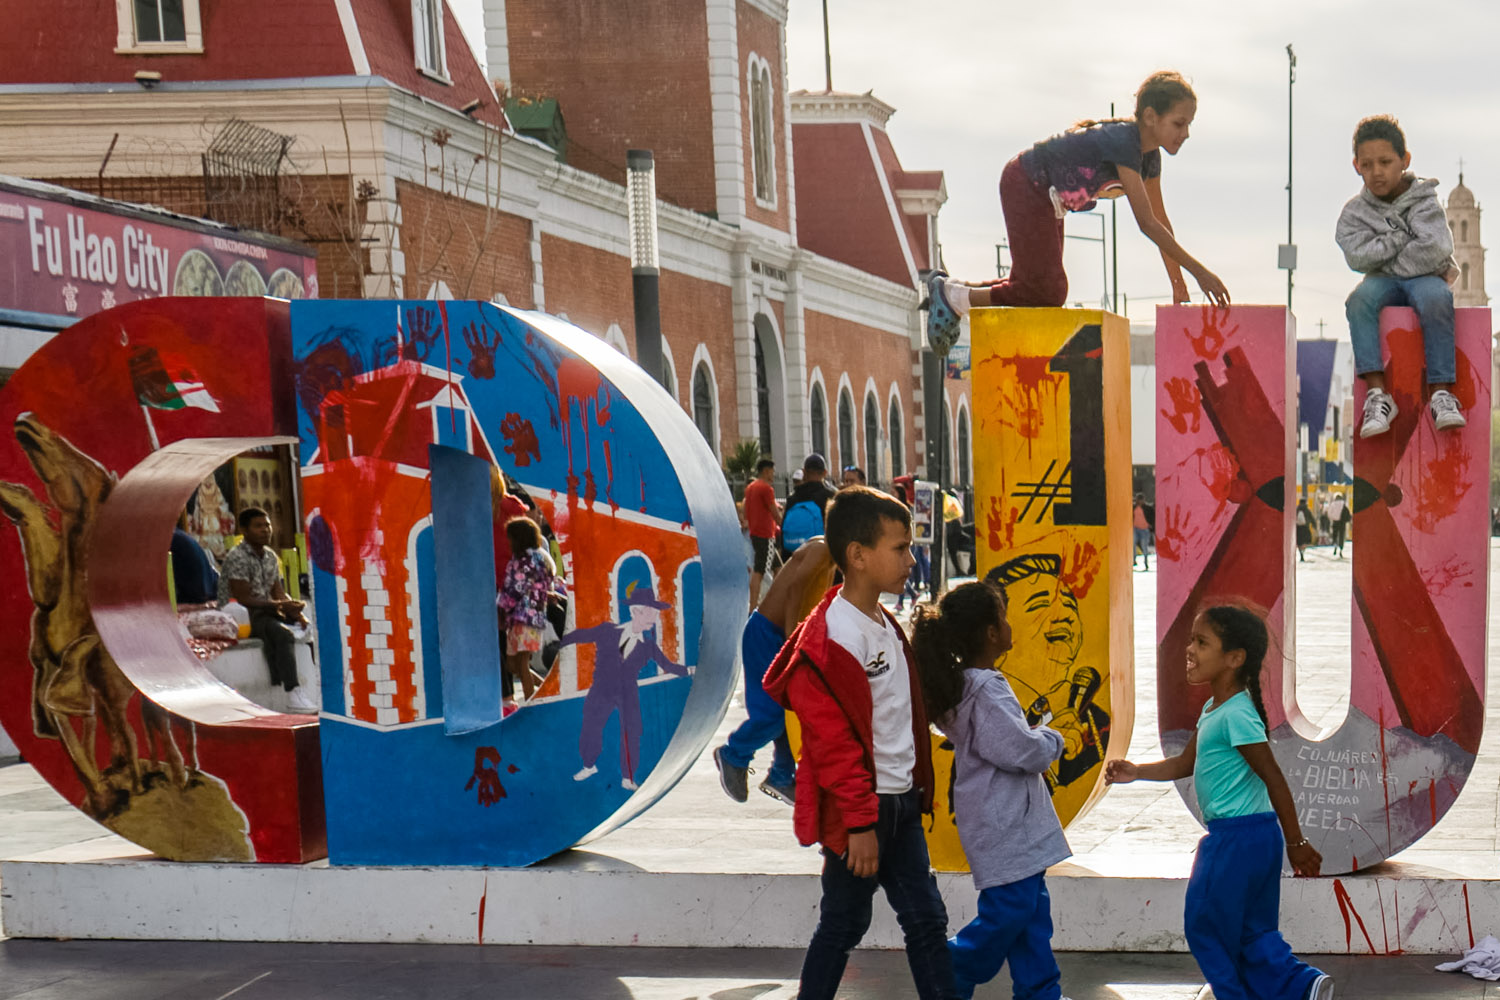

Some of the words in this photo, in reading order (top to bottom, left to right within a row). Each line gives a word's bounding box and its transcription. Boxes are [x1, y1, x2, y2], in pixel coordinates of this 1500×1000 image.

[28, 205, 64, 276] Fu
[67, 213, 118, 285] Hao
[122, 223, 169, 297] City
[1302, 764, 1373, 792] BIBLIA
[1308, 792, 1360, 806] VERDAD
